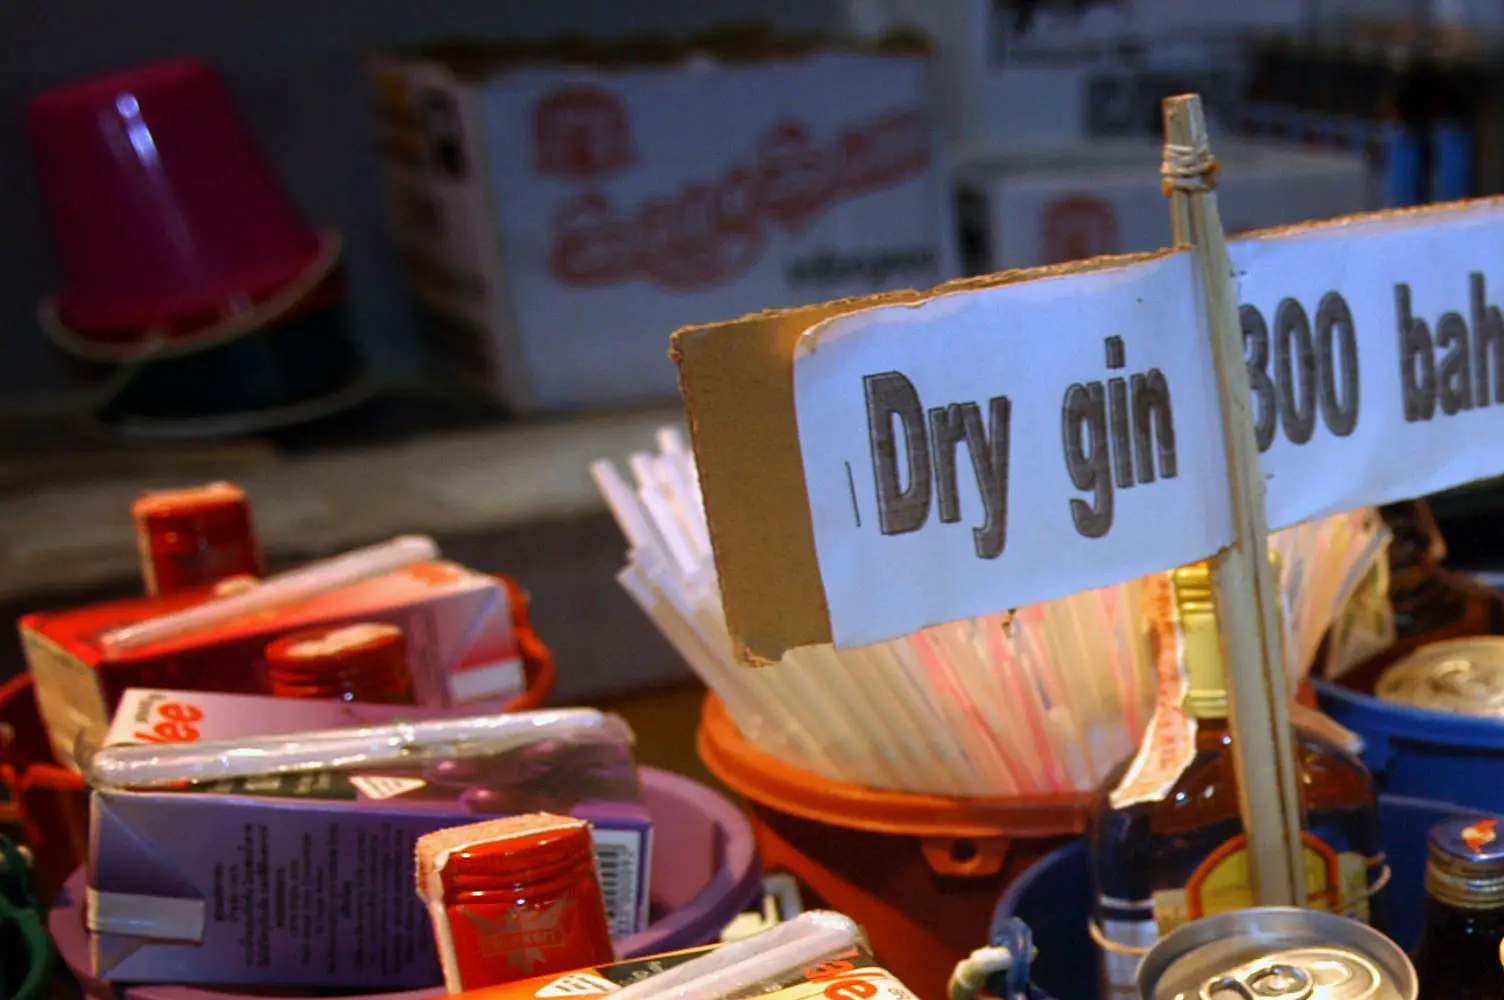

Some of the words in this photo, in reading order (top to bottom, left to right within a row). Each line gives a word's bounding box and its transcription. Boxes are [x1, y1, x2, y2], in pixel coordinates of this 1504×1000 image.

[861, 369, 1011, 560] Dry
[1061, 335, 1178, 539] gin
[1240, 290, 1360, 455] 300
[134, 702, 204, 743] lee
